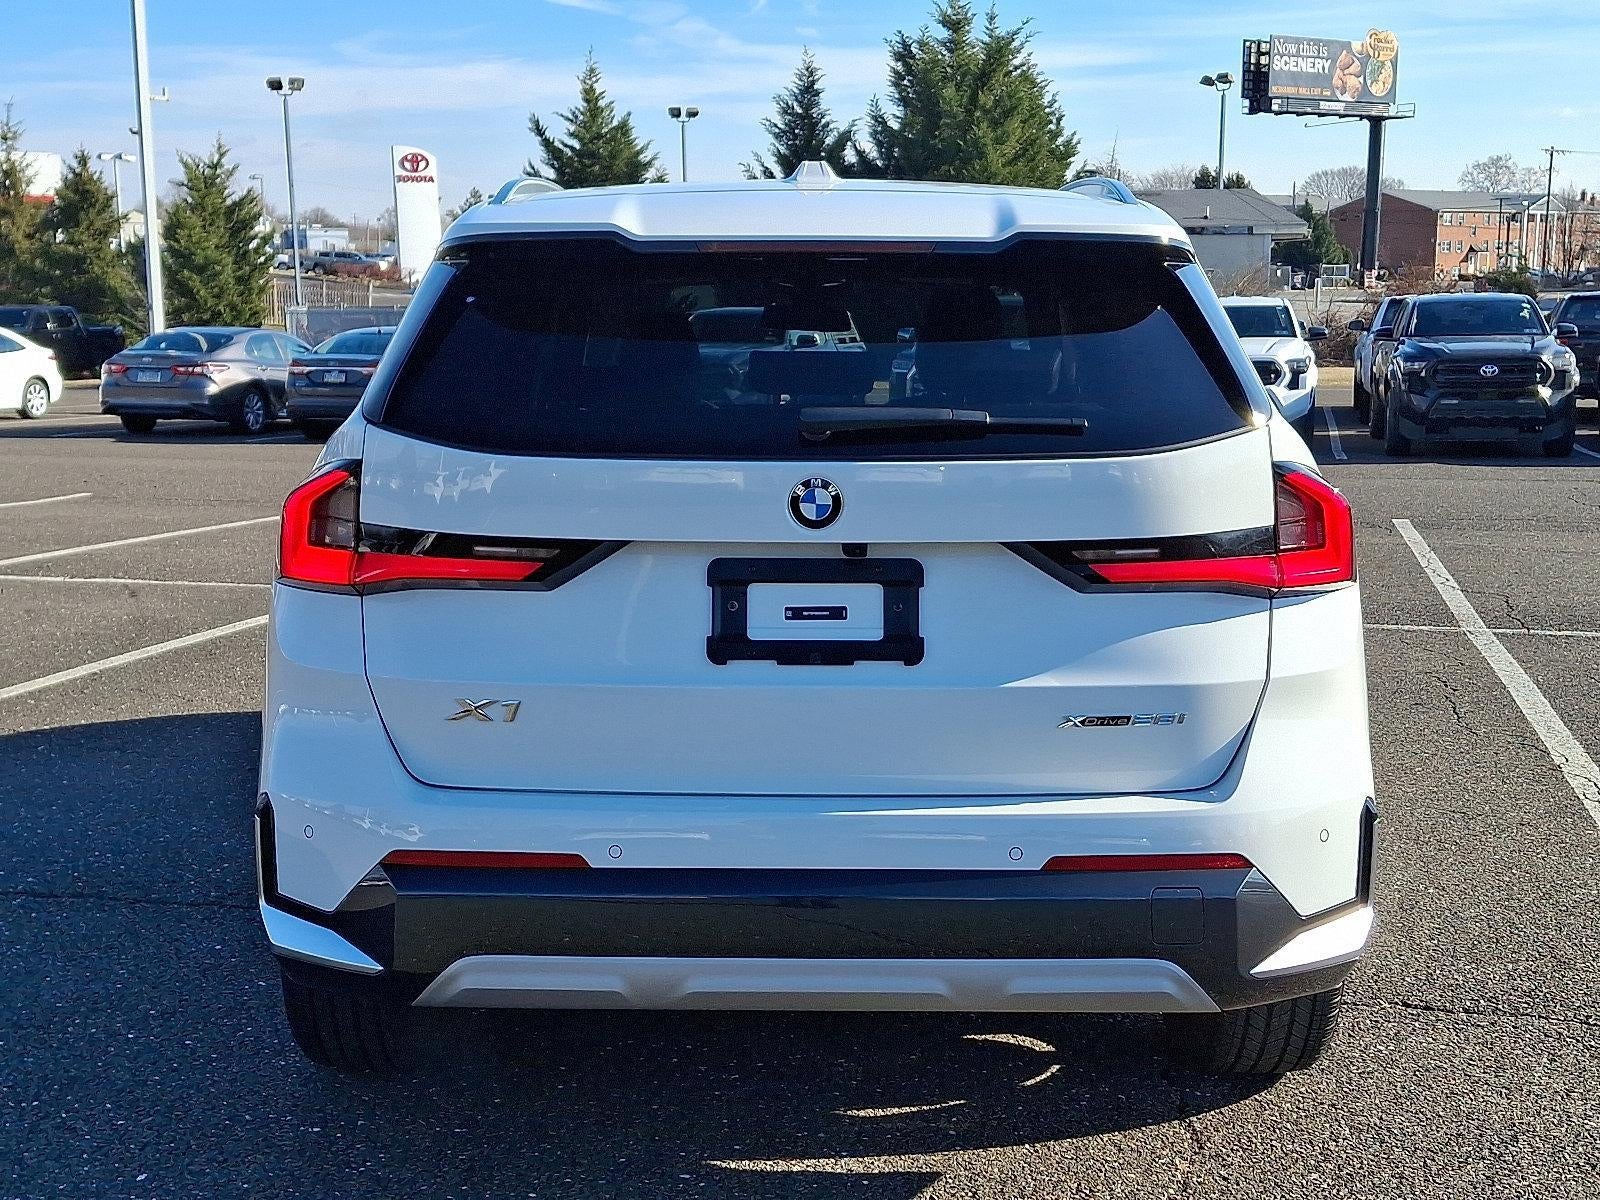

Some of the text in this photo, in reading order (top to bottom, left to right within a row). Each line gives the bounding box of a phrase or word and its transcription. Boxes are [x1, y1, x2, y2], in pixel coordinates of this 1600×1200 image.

[1273, 38, 1328, 57] Now this is
[1272, 54, 1332, 74] SCENERY
[395, 175, 434, 184] TOYOTA
[793, 478, 840, 496] BMW
[444, 697, 522, 722] X1
